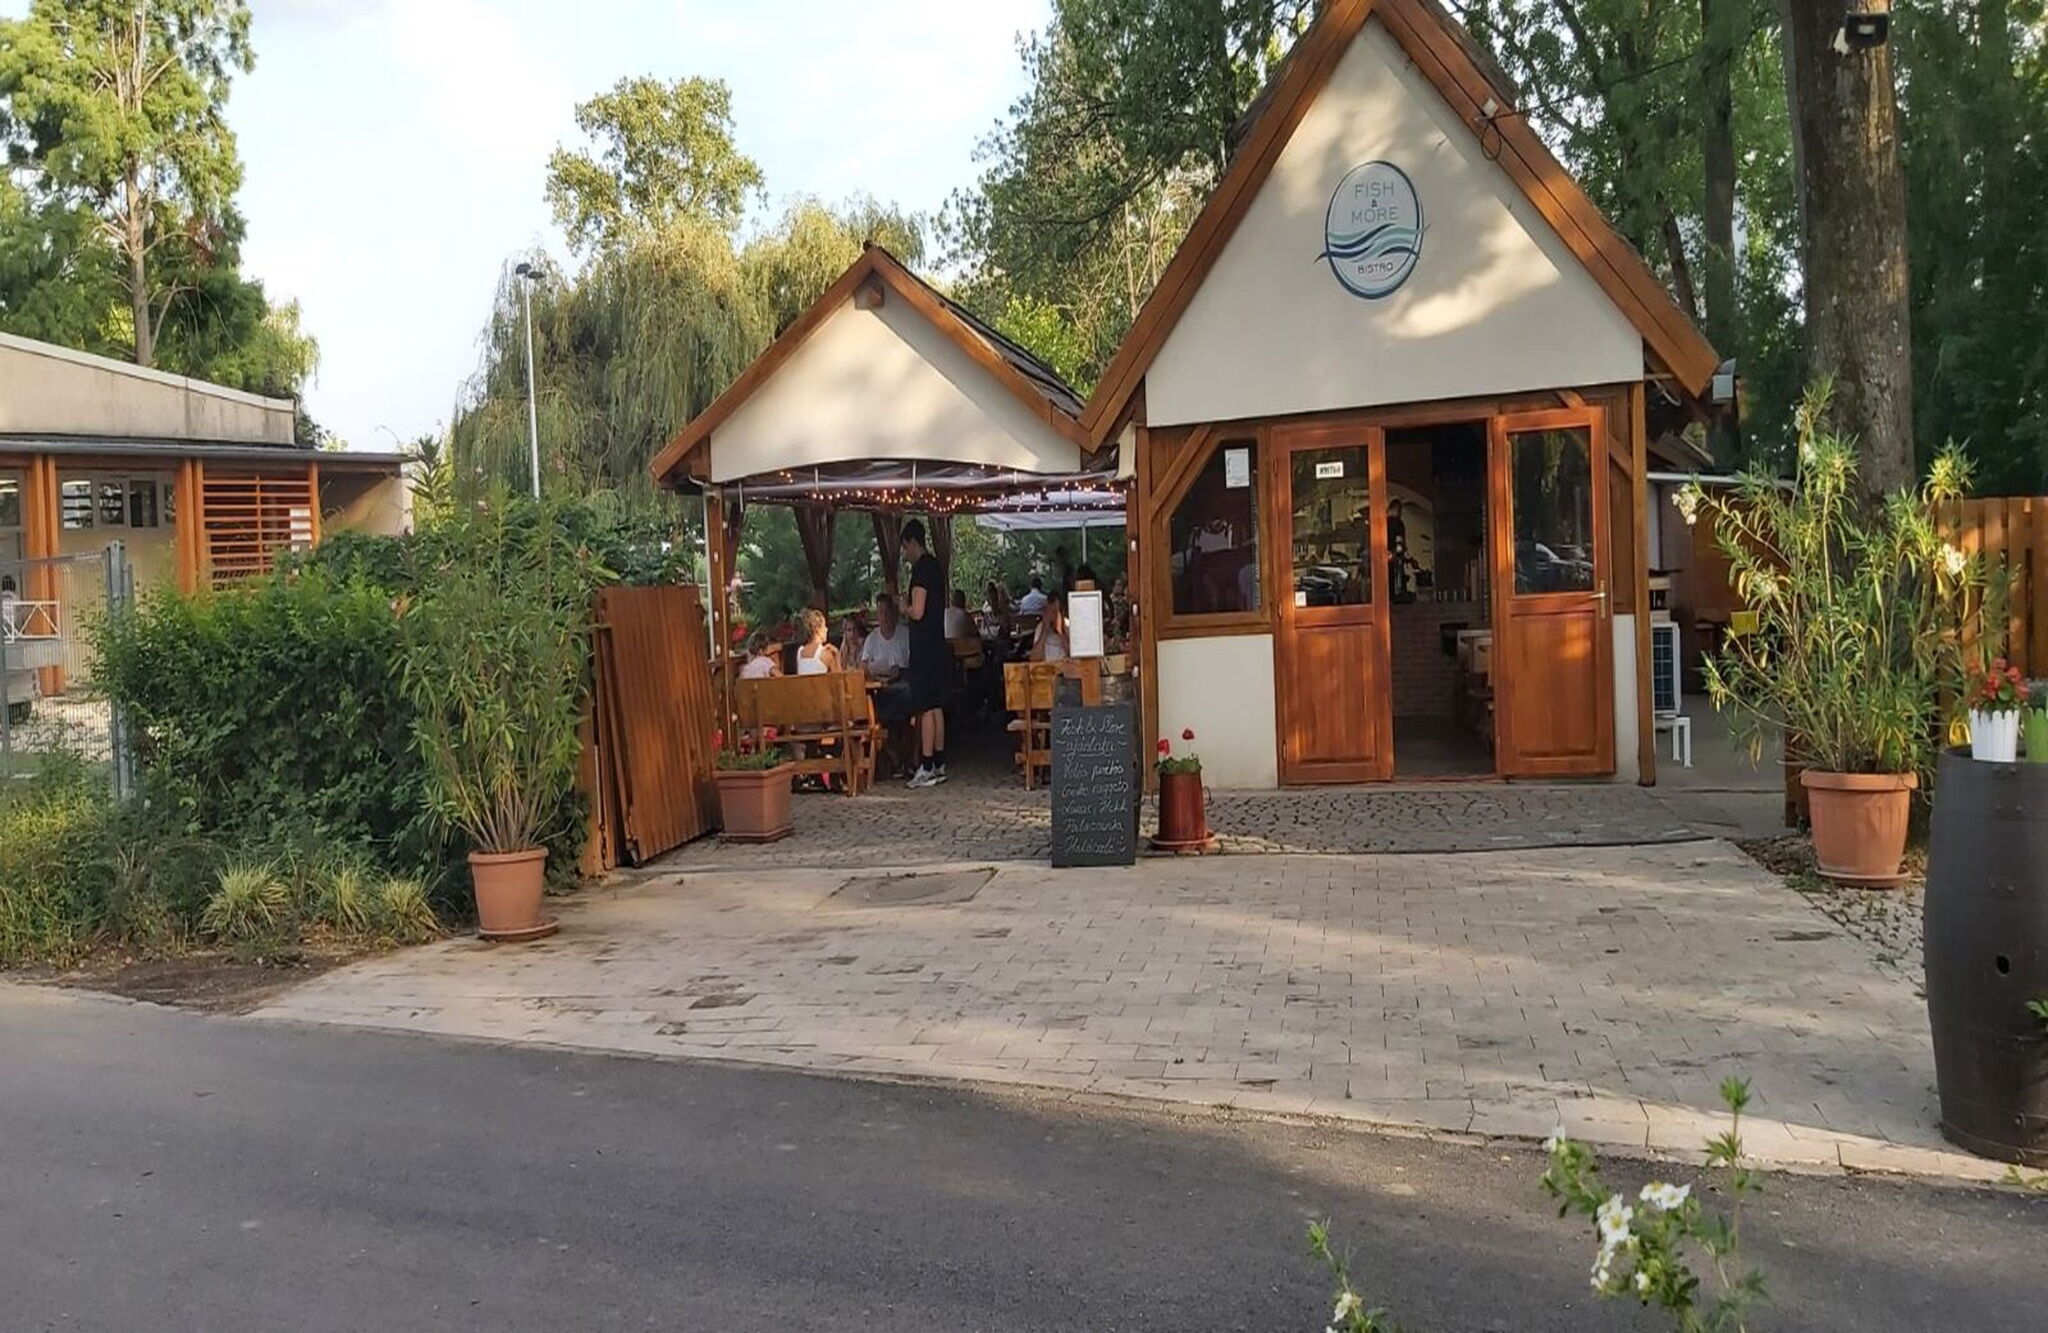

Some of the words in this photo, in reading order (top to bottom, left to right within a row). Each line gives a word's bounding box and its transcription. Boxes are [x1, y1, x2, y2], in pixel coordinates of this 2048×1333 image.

[1355, 181, 1394, 199] FISH
[1351, 207, 1398, 223] MORE
[1357, 262, 1394, 275] BISTRO
